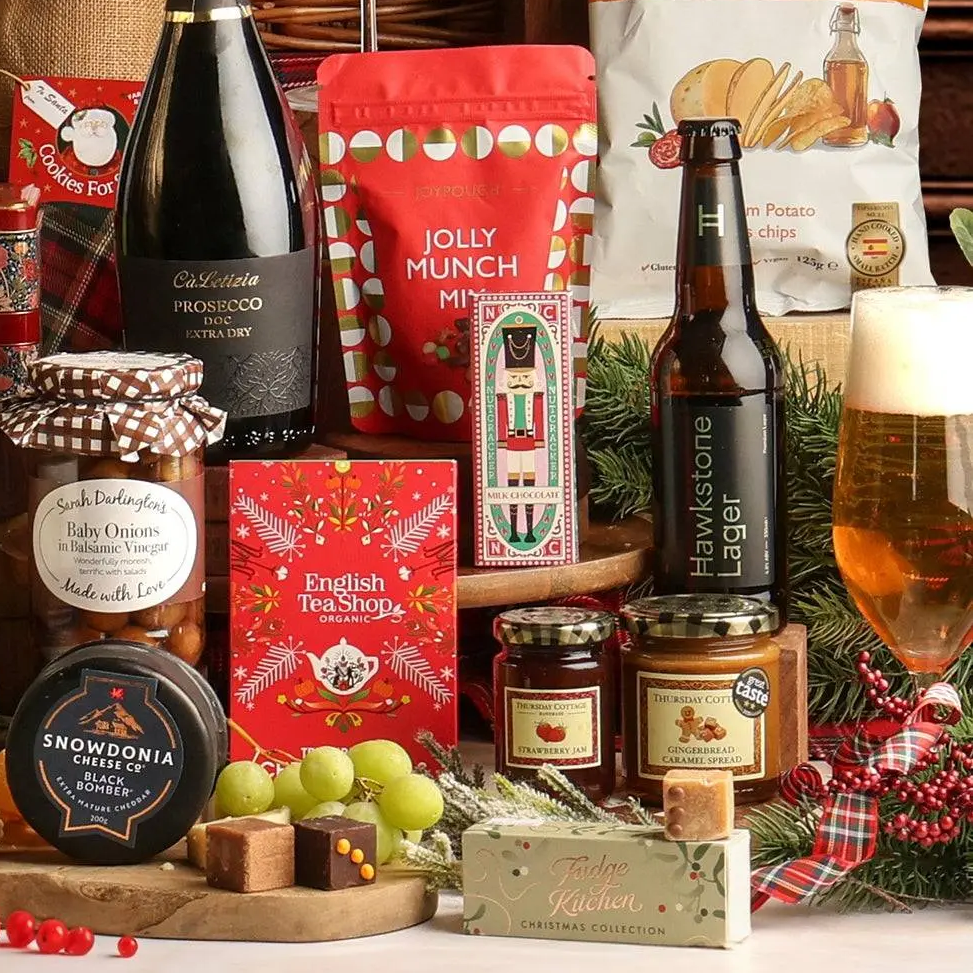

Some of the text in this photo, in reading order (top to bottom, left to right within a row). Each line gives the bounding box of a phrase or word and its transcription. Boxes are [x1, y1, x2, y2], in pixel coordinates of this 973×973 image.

[44, 93, 69, 115] Santa
[39, 144, 85, 194] Cookies
[87, 180, 115, 196] For
[766, 203, 816, 217] Potato
[698, 203, 725, 237] H
[423, 228, 498, 255] JOLLY
[758, 225, 797, 242] chips
[406, 255, 518, 280] MUNCH
[795, 255, 825, 271] 125g
[173, 297, 263, 313] PROSECCO
[204, 315, 232, 325] DOC
[185, 327, 253, 339] EXTRA DRY
[56, 488, 168, 515] Sarah Darlington's
[487, 490, 561, 500] MILK CHOCOLATE
[689, 415, 715, 577] Hawkstone
[67, 521, 160, 543] Baby Onions
[717, 493, 747, 577] Lager
[58, 539, 170, 556] in Balsamic Vinegar
[60, 578, 166, 602] Made with Love
[304, 573, 386, 597] English
[319, 614, 371, 624] ORGANIC
[653, 693, 703, 705] THURSDAY
[735, 681, 769, 707] taste
[42, 733, 174, 766] SNOWDONIA
[517, 746, 571, 755] STRAWBERRY
[667, 745, 735, 755] GINGERBREAD
[73, 754, 122, 770] CHEESE
[662, 755, 742, 765] CARAMEL SPREAD
[84, 771, 125, 787] BLACK
[56, 776, 151, 813] EXTRA MATURE CHEDDAR
[90, 814, 109, 825] 200g
[550, 854, 629, 894] Fudge
[549, 883, 643, 918] Kitchen
[521, 920, 667, 936] CHRISTMAS COLLECTION
